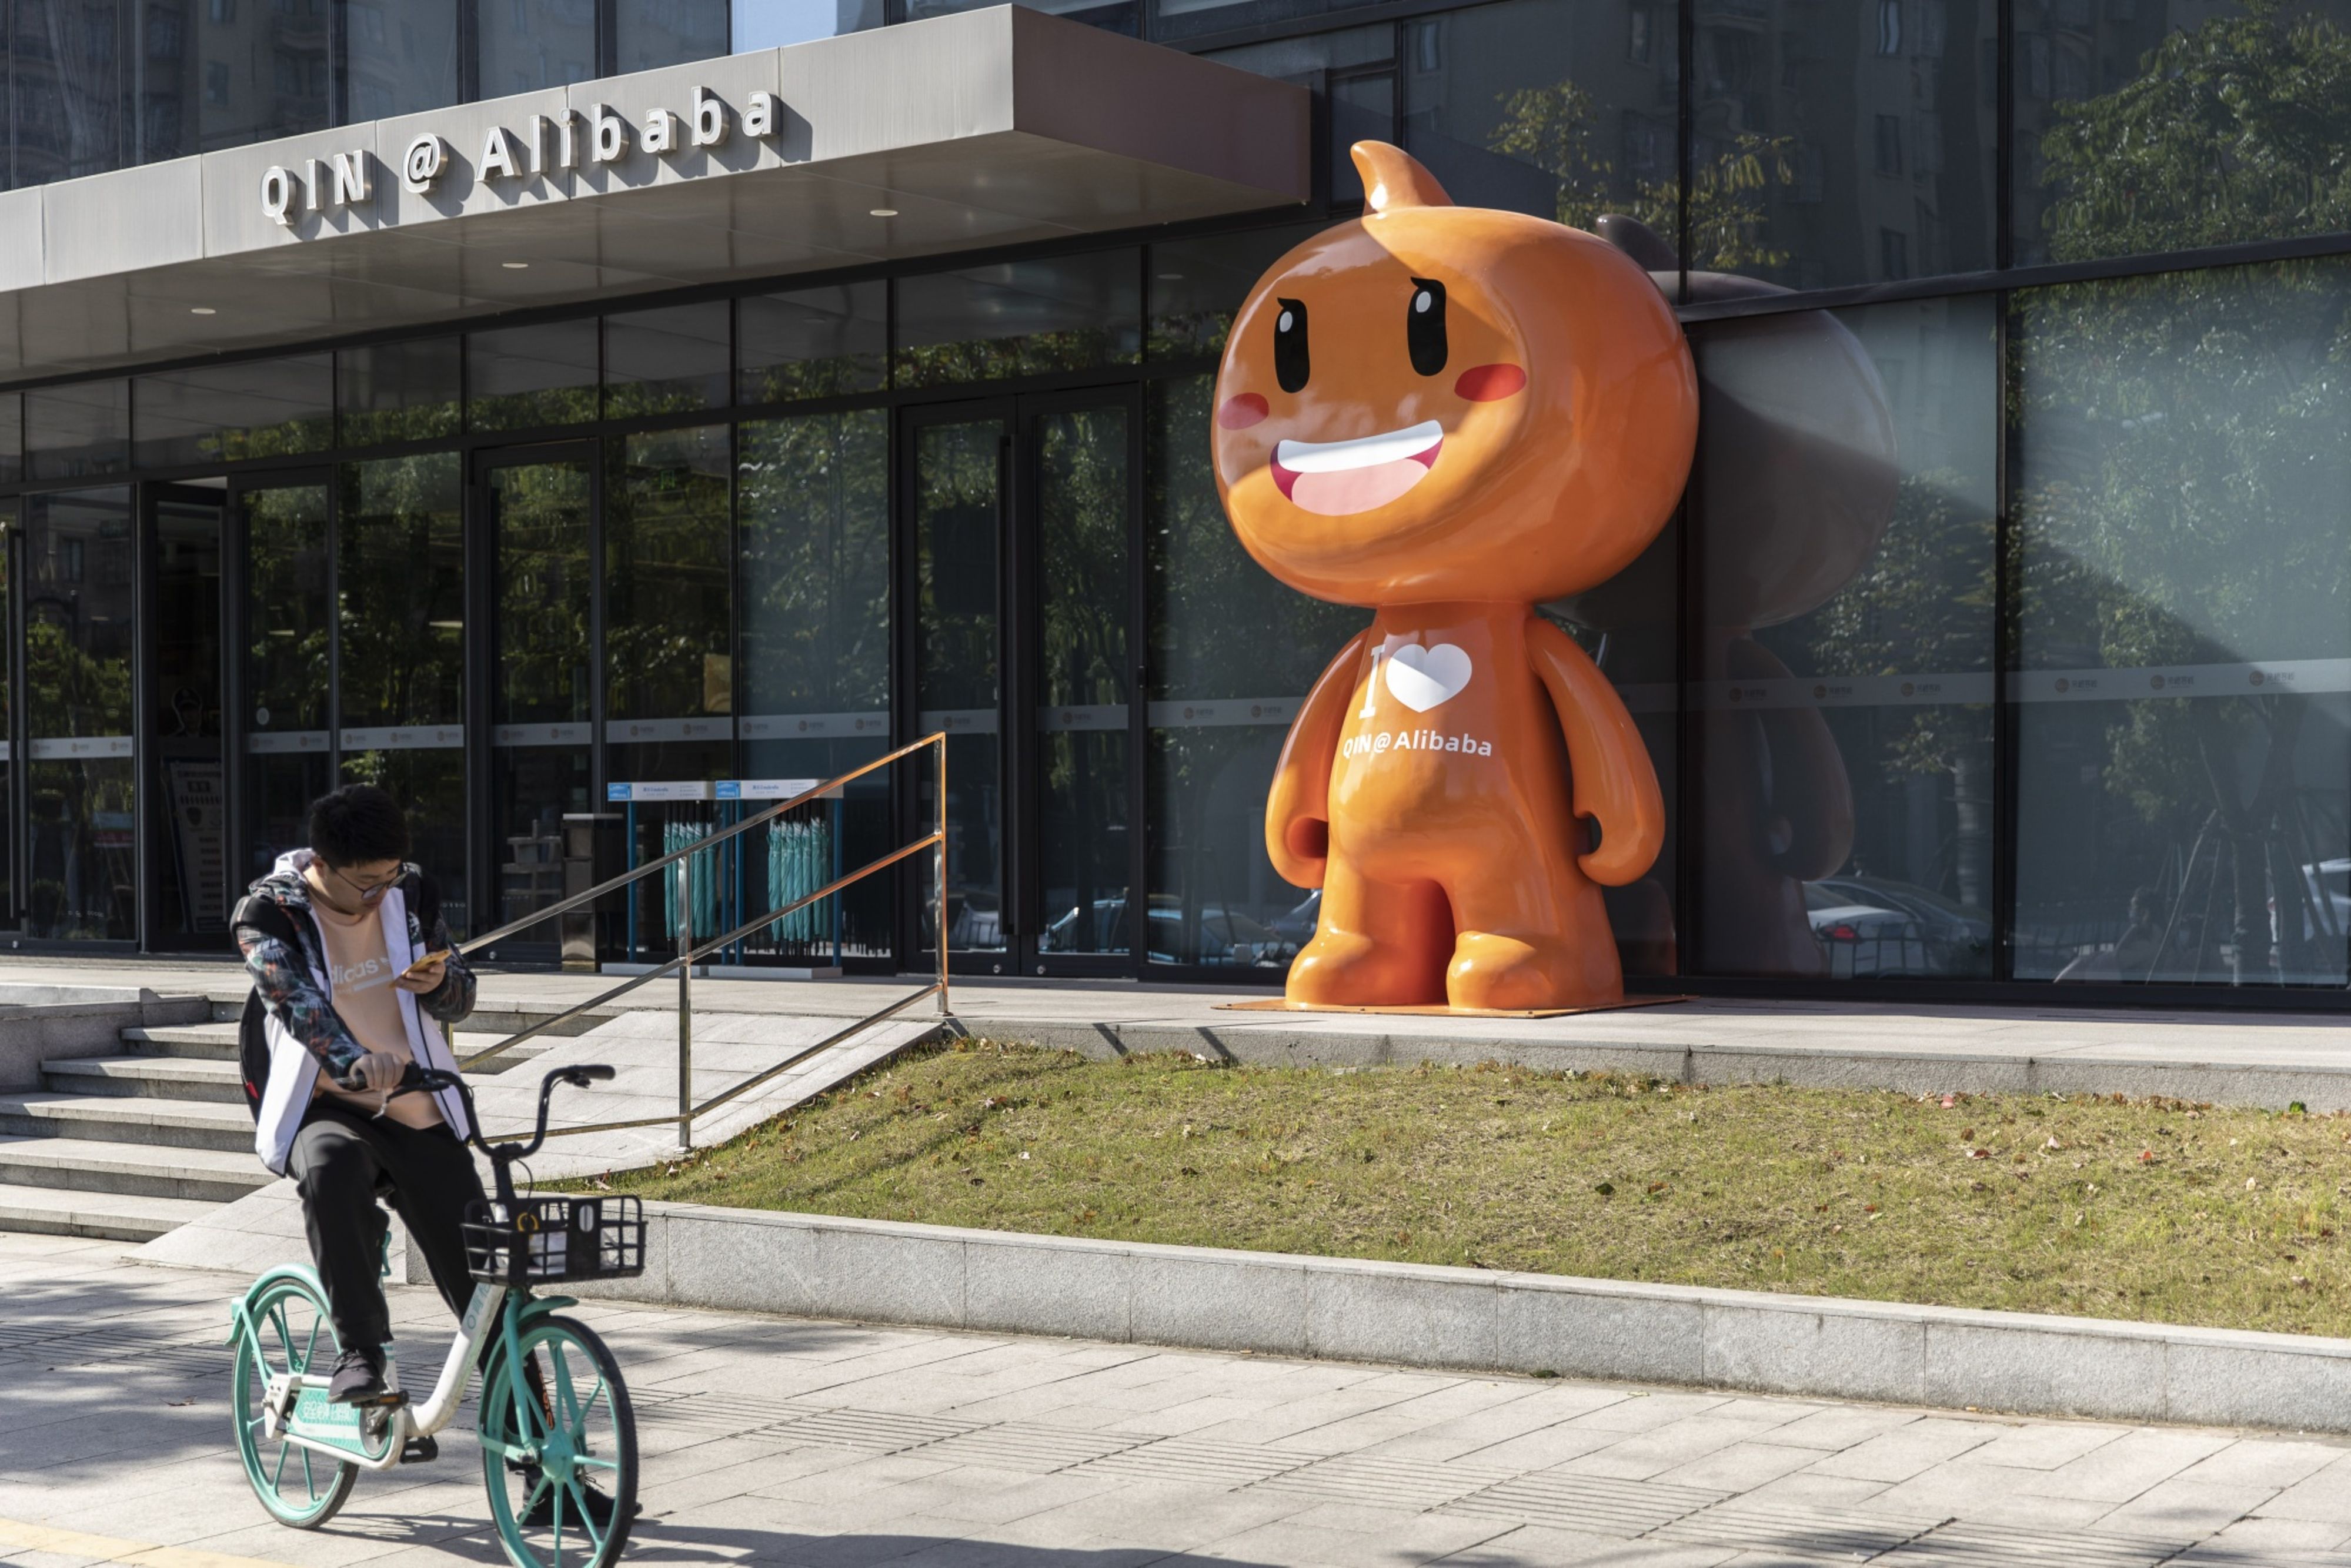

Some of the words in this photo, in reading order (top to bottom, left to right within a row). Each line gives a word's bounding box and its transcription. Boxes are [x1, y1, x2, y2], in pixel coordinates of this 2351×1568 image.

[261, 149, 372, 226] QIN
[403, 133, 448, 195] @
[475, 86, 779, 182] Alibaba
[1360, 645, 1385, 718] I
